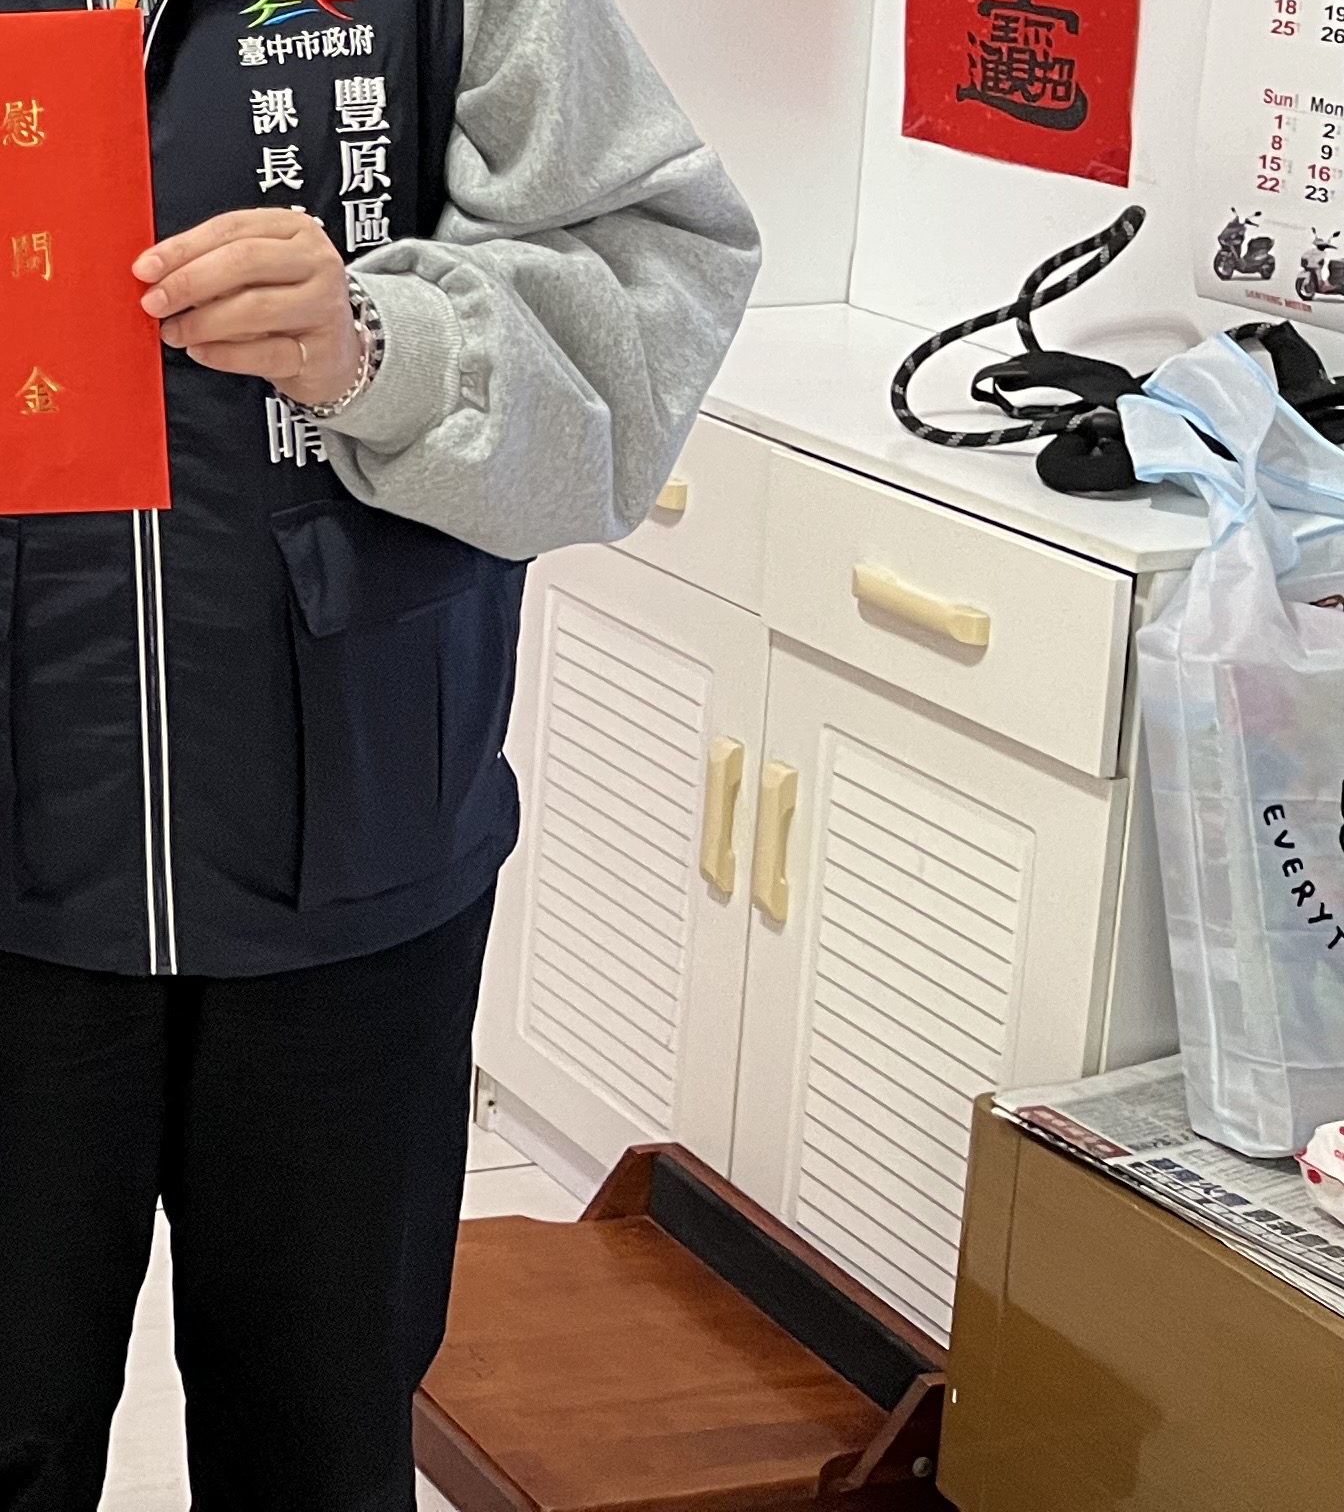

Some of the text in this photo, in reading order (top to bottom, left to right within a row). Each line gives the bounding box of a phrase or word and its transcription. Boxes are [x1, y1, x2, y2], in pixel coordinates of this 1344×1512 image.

[1270, 19, 1344, 44] 25 26
[237, 24, 375, 67] 臺中市政府
[1263, 88, 1344, 117] Sun Mon
[1274, 114, 1336, 139] 1 2
[1271, 135, 1333, 160] 8 9
[1258, 154, 1331, 181] 15 16
[1257, 175, 1329, 203] 22 23
[0, 99, 65, 417] 慰問金
